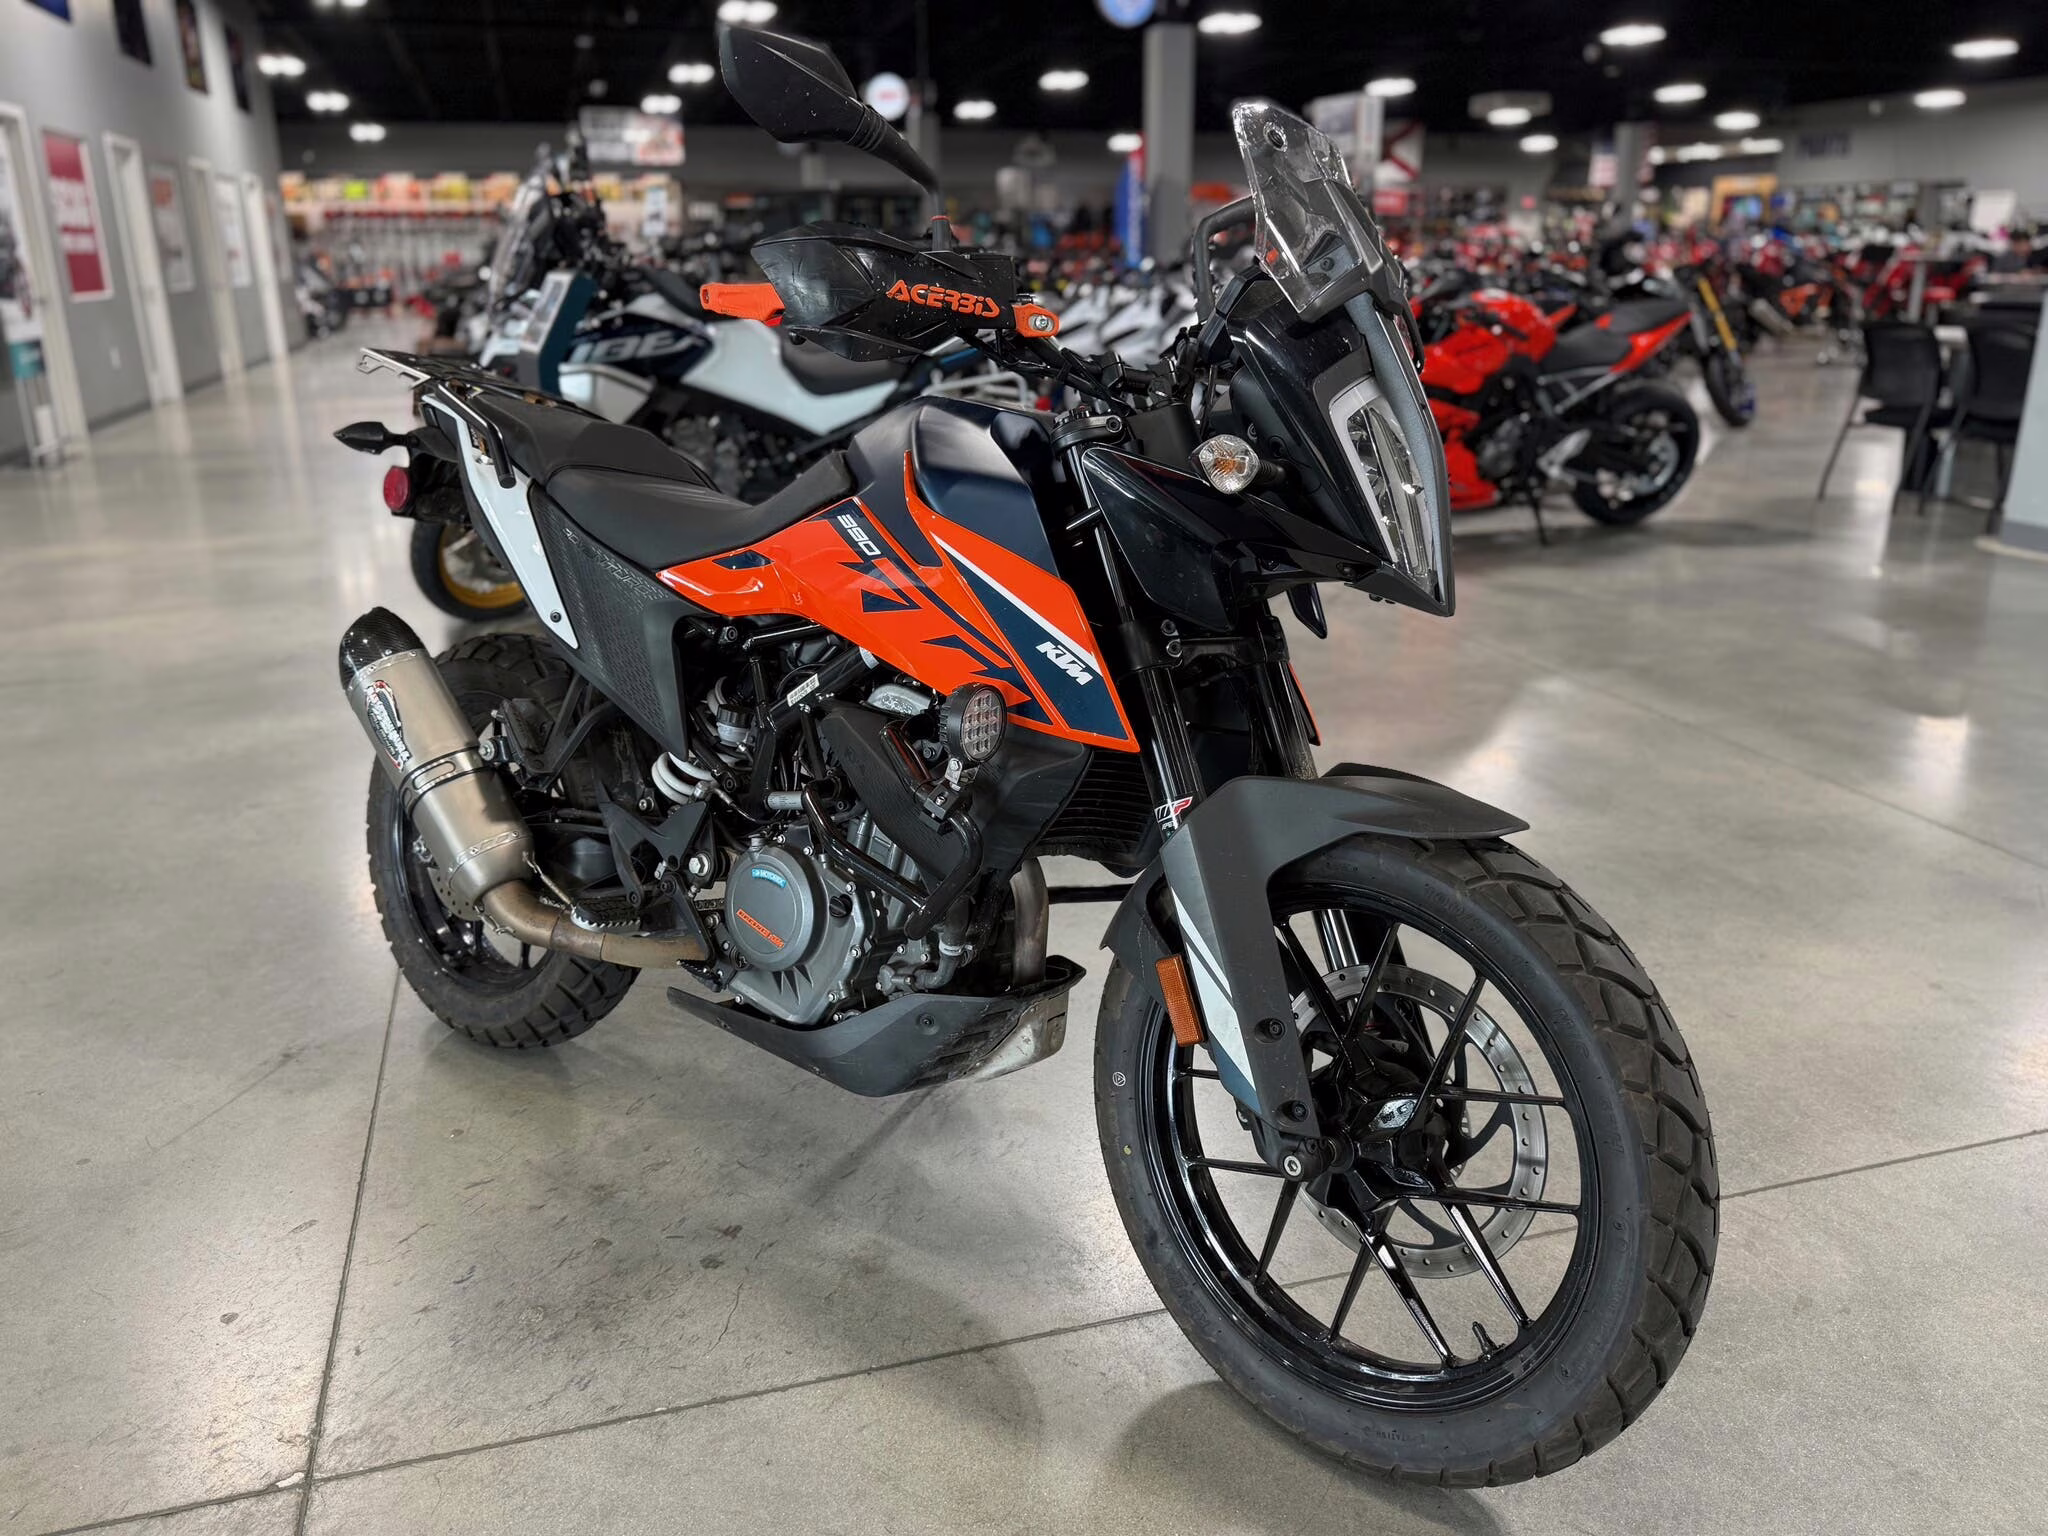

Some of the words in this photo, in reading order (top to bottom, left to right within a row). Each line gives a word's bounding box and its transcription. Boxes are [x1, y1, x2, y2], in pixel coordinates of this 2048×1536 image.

[885, 279, 1000, 318] ACERBIS
[836, 513, 882, 556] 390
[1035, 641, 1093, 686] KTM
